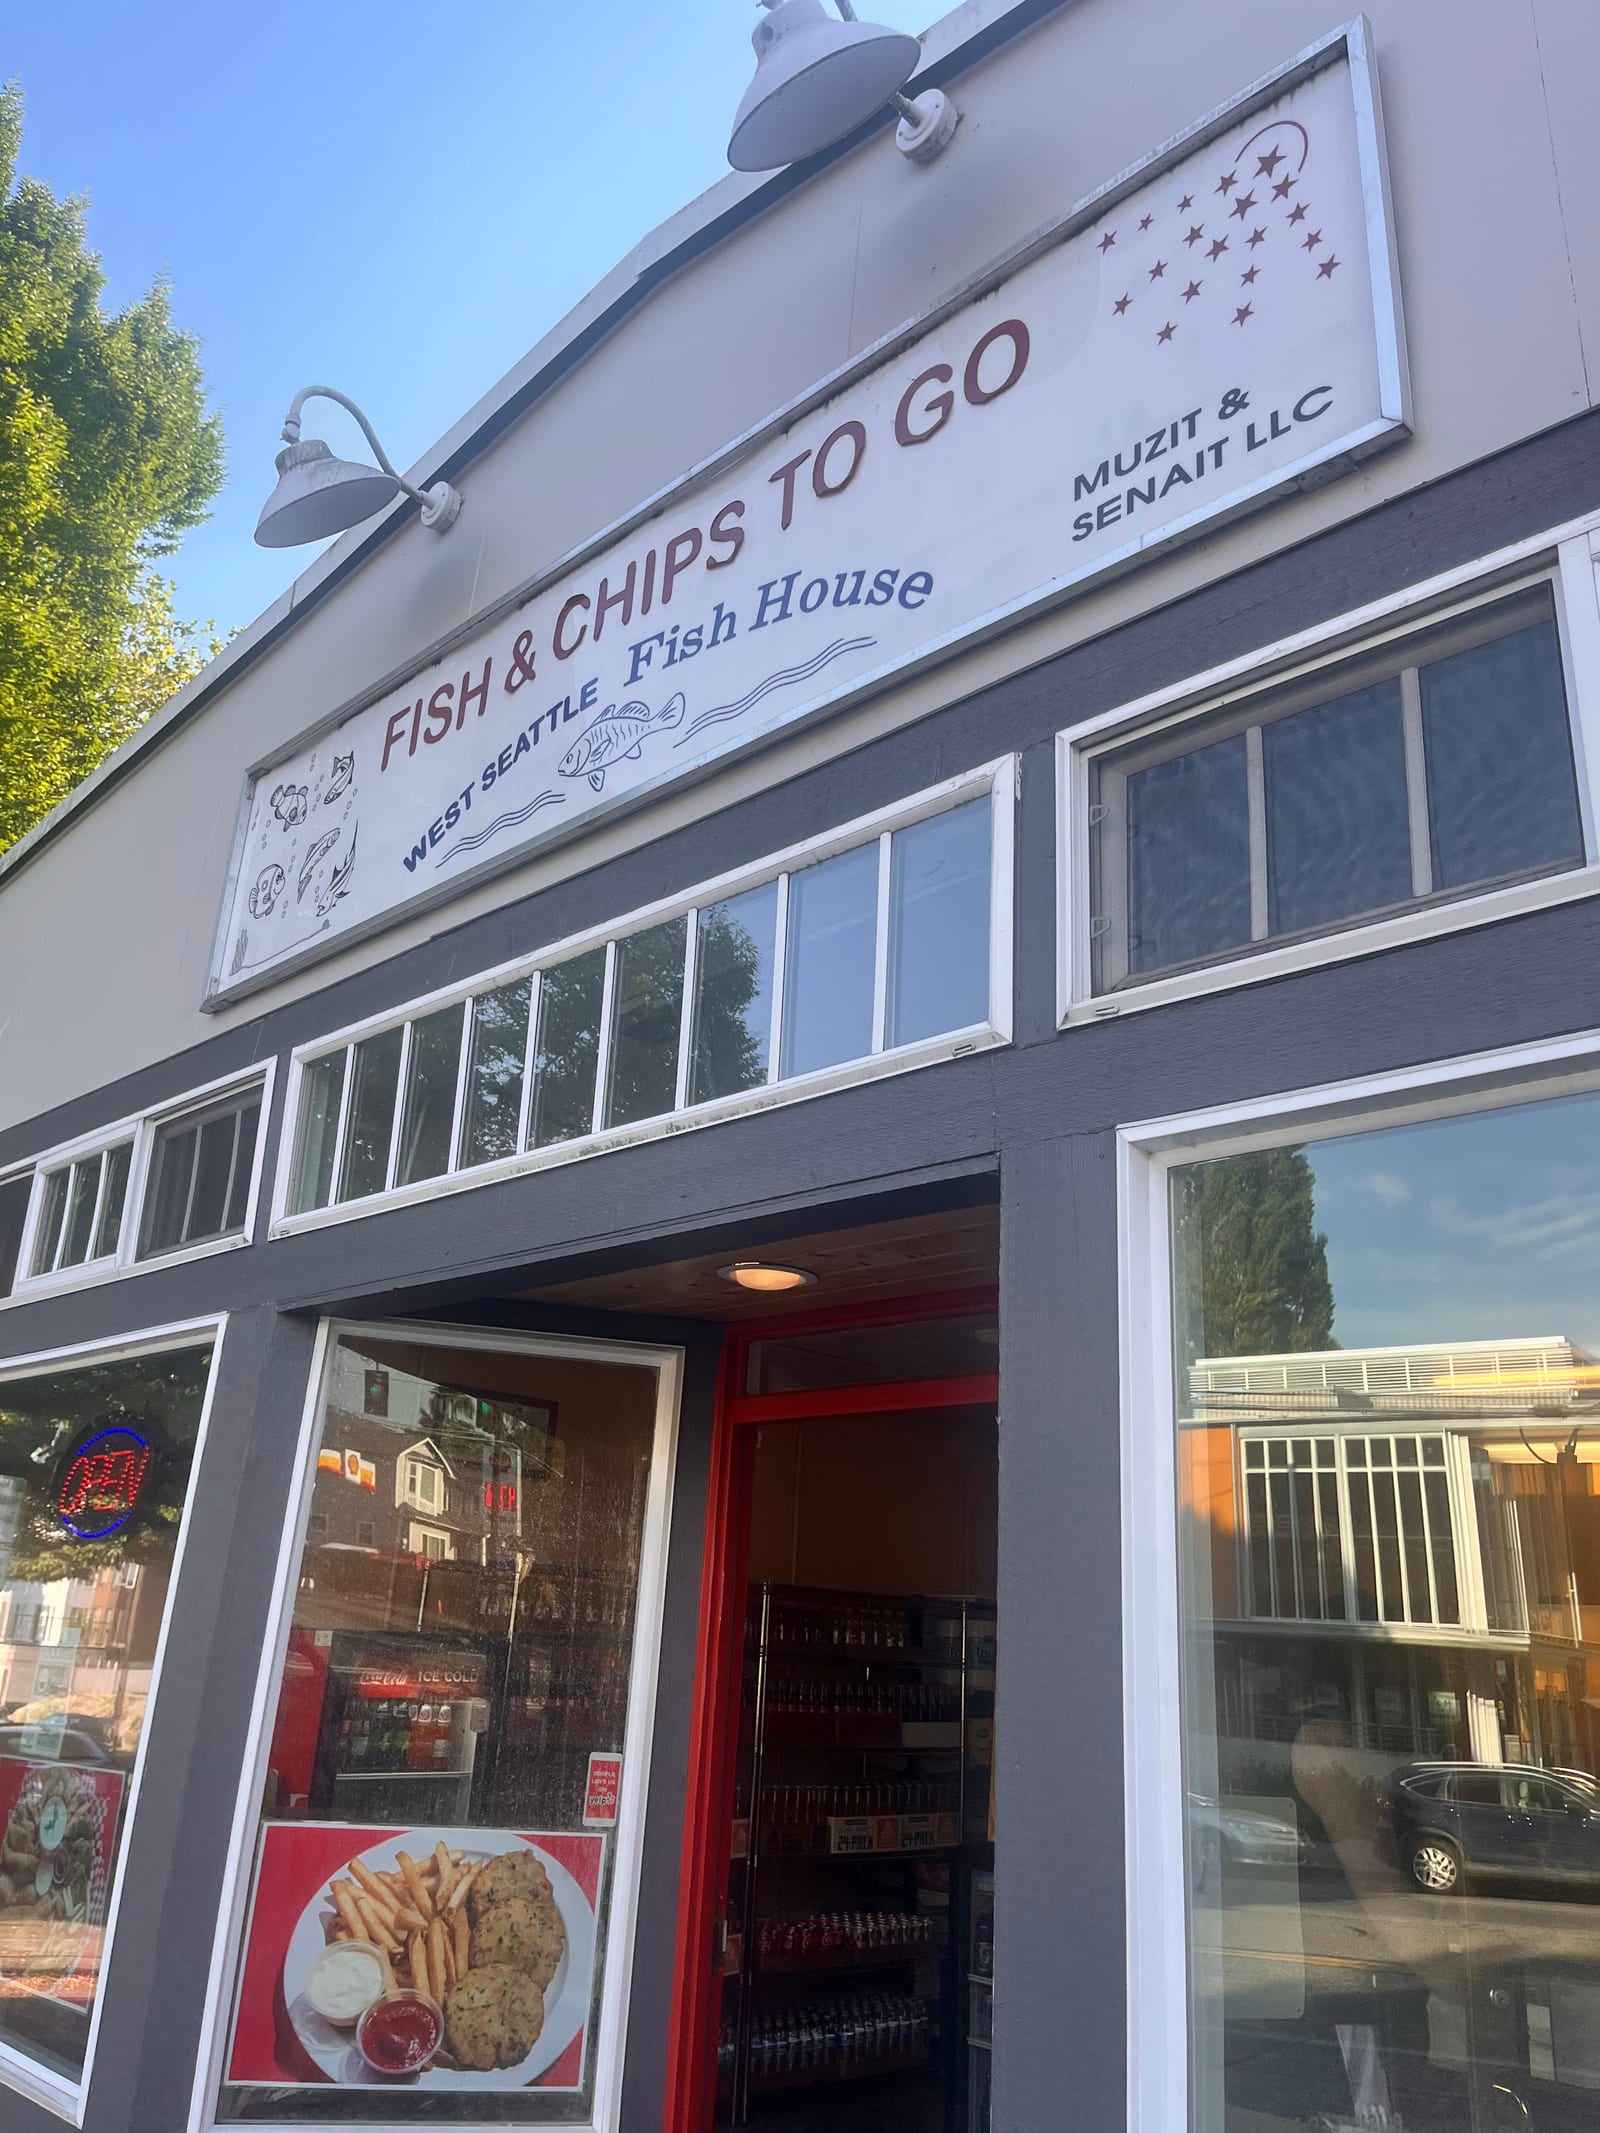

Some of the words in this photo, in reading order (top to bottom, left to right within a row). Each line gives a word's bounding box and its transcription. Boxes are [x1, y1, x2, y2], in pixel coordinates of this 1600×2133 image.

[1072, 437, 1229, 542] SENAIT
[1246, 385, 1334, 452] LLC
[1073, 407, 1202, 502] MUZIT
[1217, 388, 1250, 420] &
[380, 656, 492, 771] FISH
[504, 629, 537, 694] &
[552, 500, 745, 660] CHIPS
[768, 420, 867, 530] TO
[894, 319, 1031, 446] GO
[403, 779, 477, 873] WEST
[481, 677, 600, 792] SEATTLE
[623, 603, 737, 687] Fish
[748, 569, 934, 633] House
[59, 1447, 150, 1514] OPEN
[418, 1670, 442, 1683] ICE
[444, 1670, 479, 1683] COLD
[589, 1795, 608, 1806] yelp
